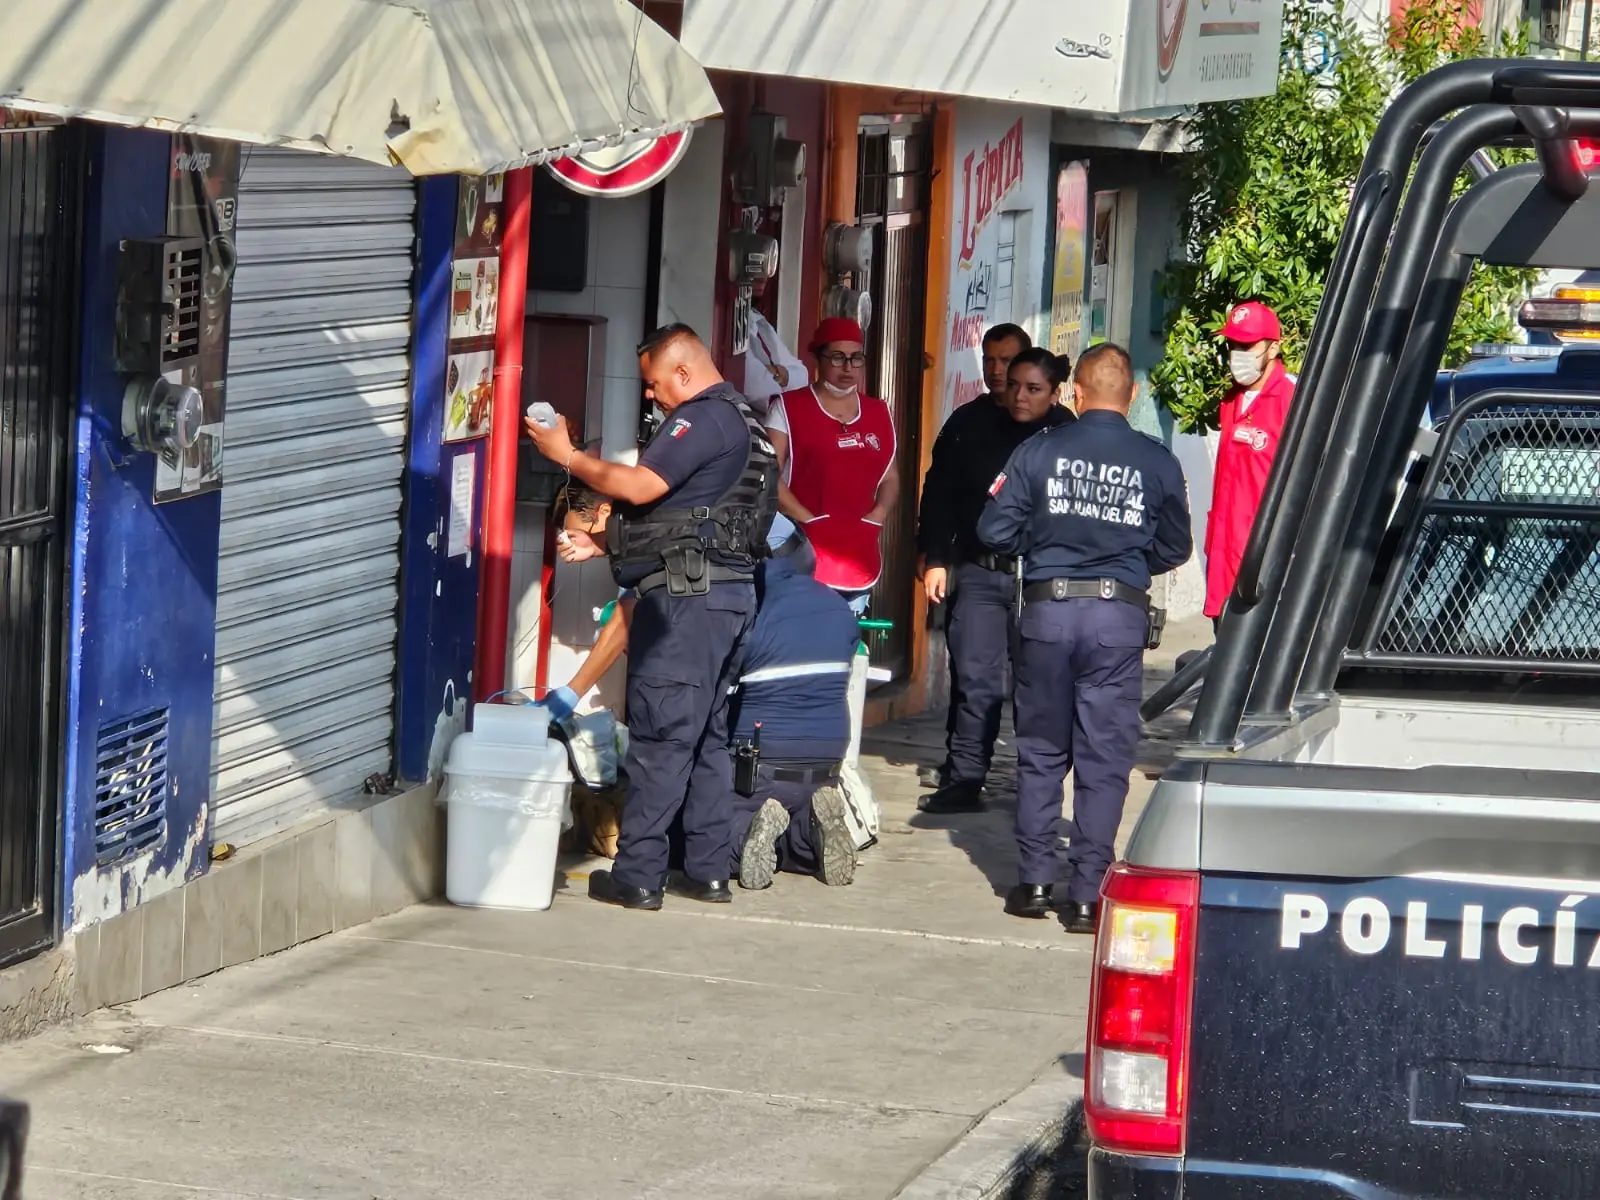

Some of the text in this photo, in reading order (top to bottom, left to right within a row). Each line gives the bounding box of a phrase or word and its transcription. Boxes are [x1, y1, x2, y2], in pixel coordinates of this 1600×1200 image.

[1047, 477, 1145, 511] MUNICIPAL
[1049, 498, 1071, 515] SAN
[1070, 500, 1101, 519] JUAN
[1101, 505, 1122, 523] DEL
[1280, 894, 1600, 967] POLICÍ
